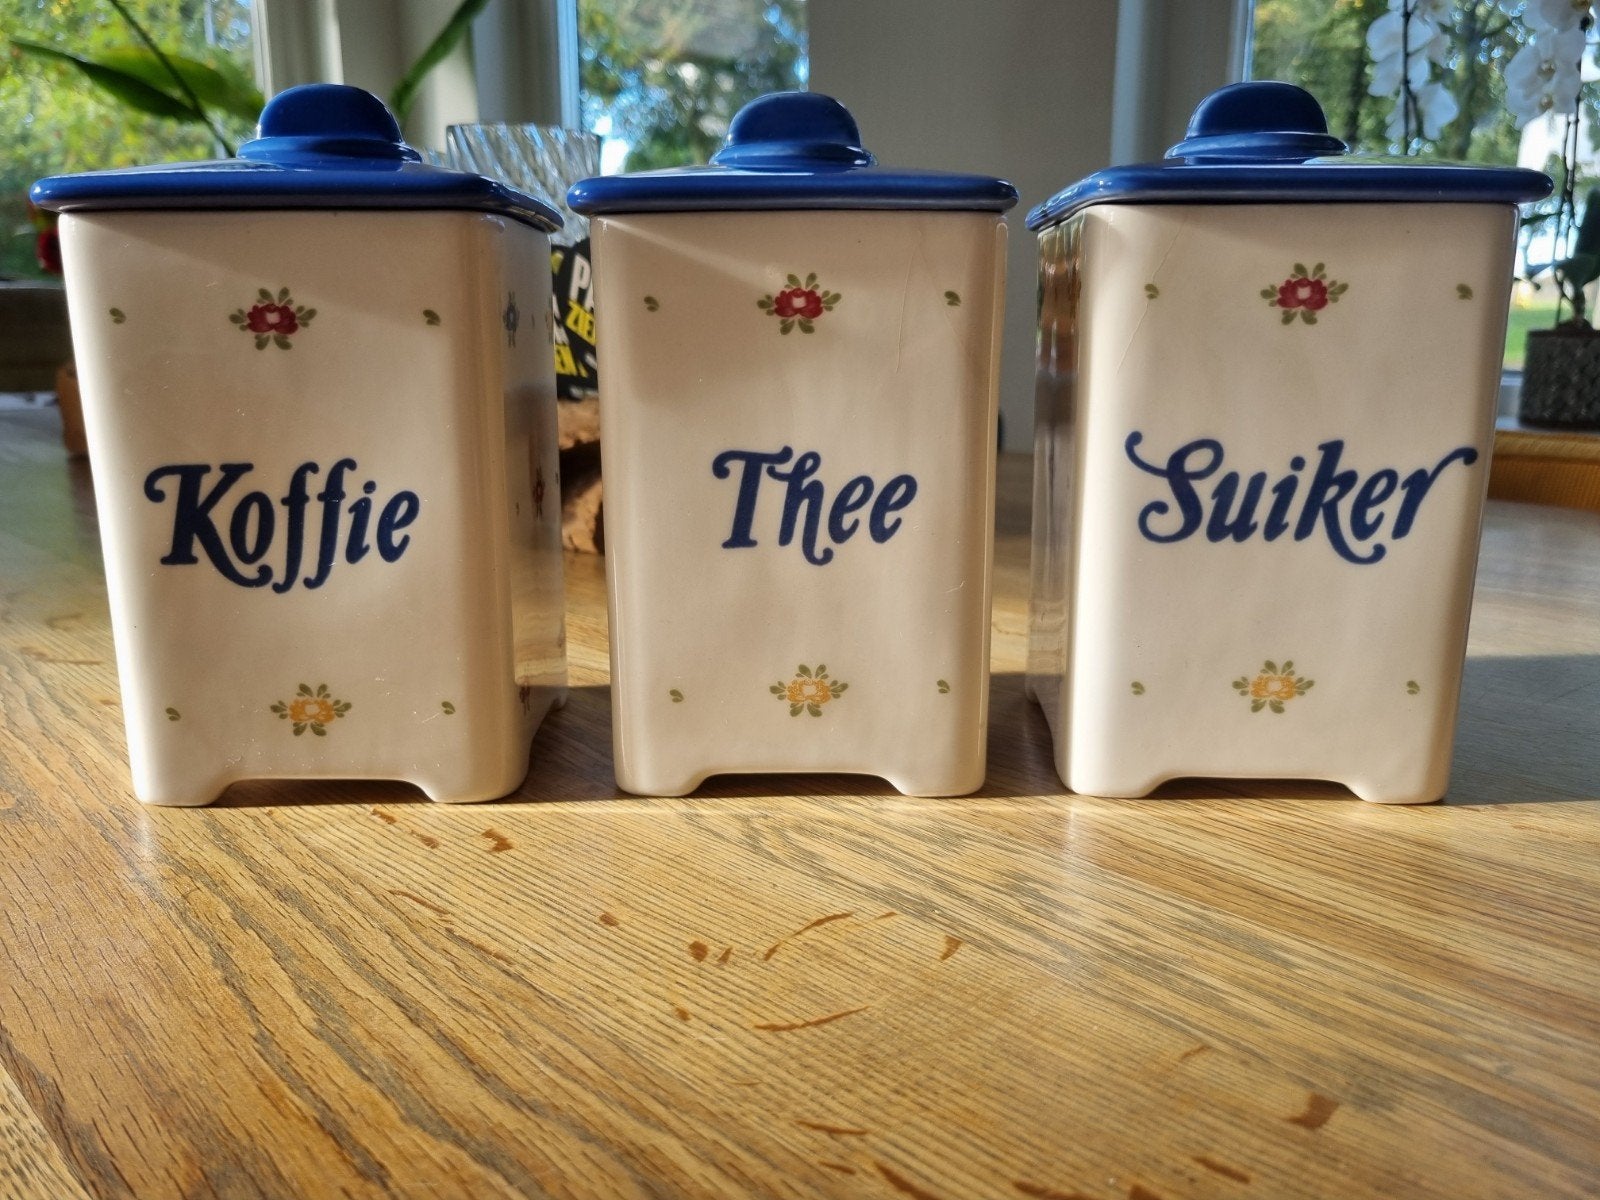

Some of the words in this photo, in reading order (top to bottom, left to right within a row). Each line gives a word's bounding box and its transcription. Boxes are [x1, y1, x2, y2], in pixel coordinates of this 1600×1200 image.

[144, 457, 420, 592] Koffie
[712, 445, 918, 565] Thee
[1125, 431, 1479, 564] Suiker
